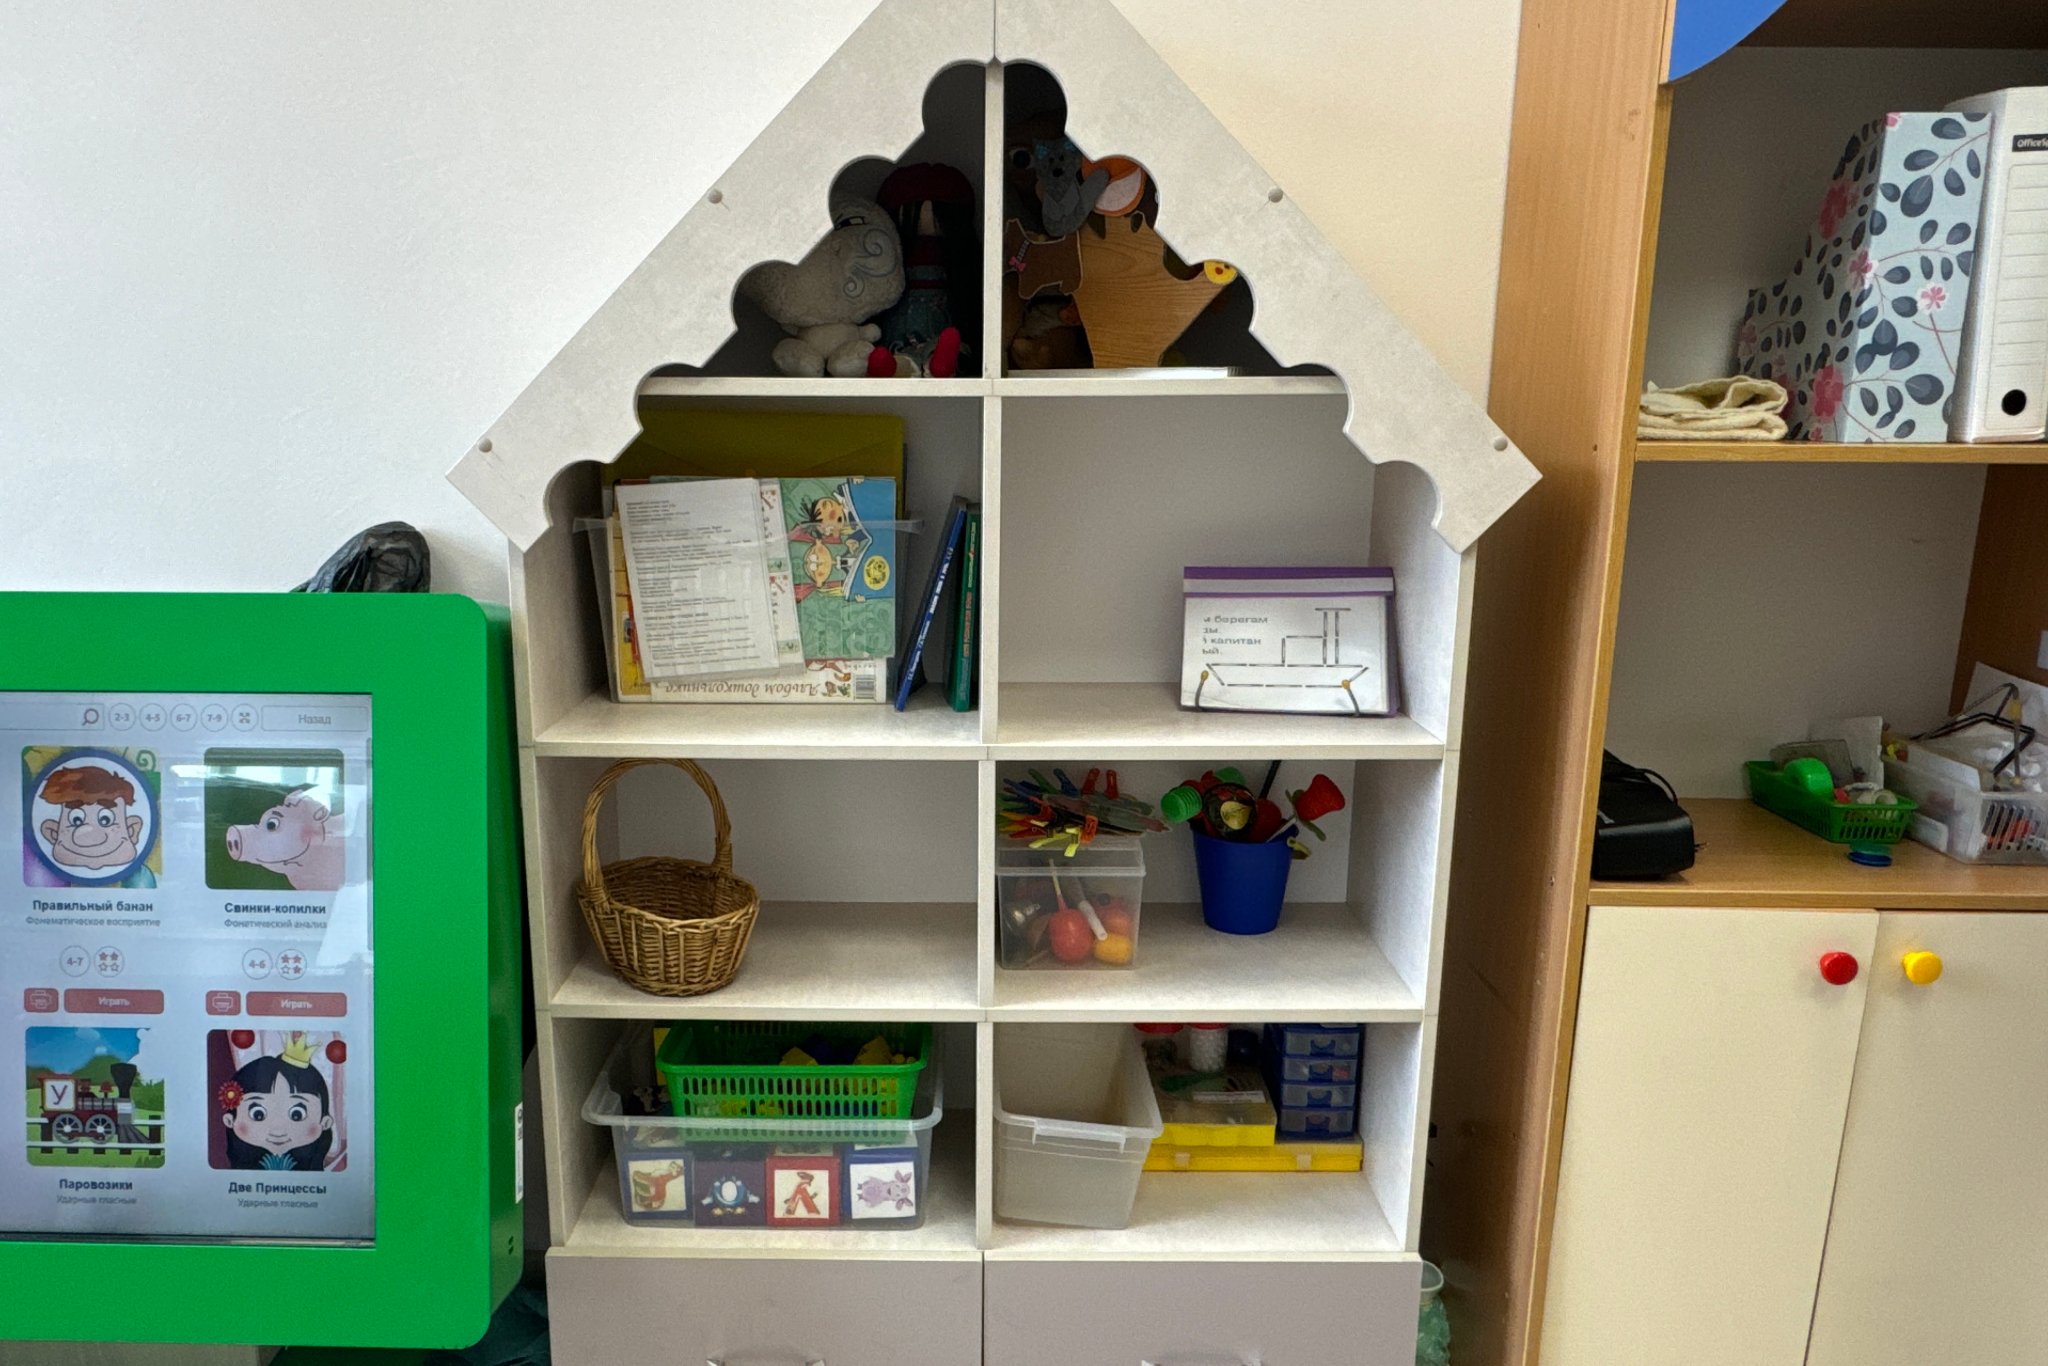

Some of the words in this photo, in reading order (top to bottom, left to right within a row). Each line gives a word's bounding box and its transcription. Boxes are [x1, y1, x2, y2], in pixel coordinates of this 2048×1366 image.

[1214, 615, 1268, 624] берегам
[1210, 637, 1262, 645] капитан
[764, 681, 821, 697] Альбом
[114, 713, 130, 722] 2-3
[145, 713, 161, 723] 4-5
[175, 713, 191, 723] 6-7
[207, 713, 223, 723] 7-9
[297, 713, 332, 727] Назад
[32, 900, 113, 912] Правильный
[116, 900, 153, 912] банан
[224, 902, 326, 914] Свинки-копилки
[224, 918, 292, 928] Фонетический
[294, 920, 327, 929] анализ
[66, 956, 84, 967] 4-7
[248, 960, 266, 970] 4-6
[98, 996, 130, 1007] Играть
[280, 998, 312, 1010] Играть
[59, 1179, 133, 1191] Паровозики
[228, 1182, 252, 1194] Две
[255, 1182, 327, 1195] Принцессы
[237, 1198, 279, 1208] Ударные
[280, 1200, 319, 1209] гласные
